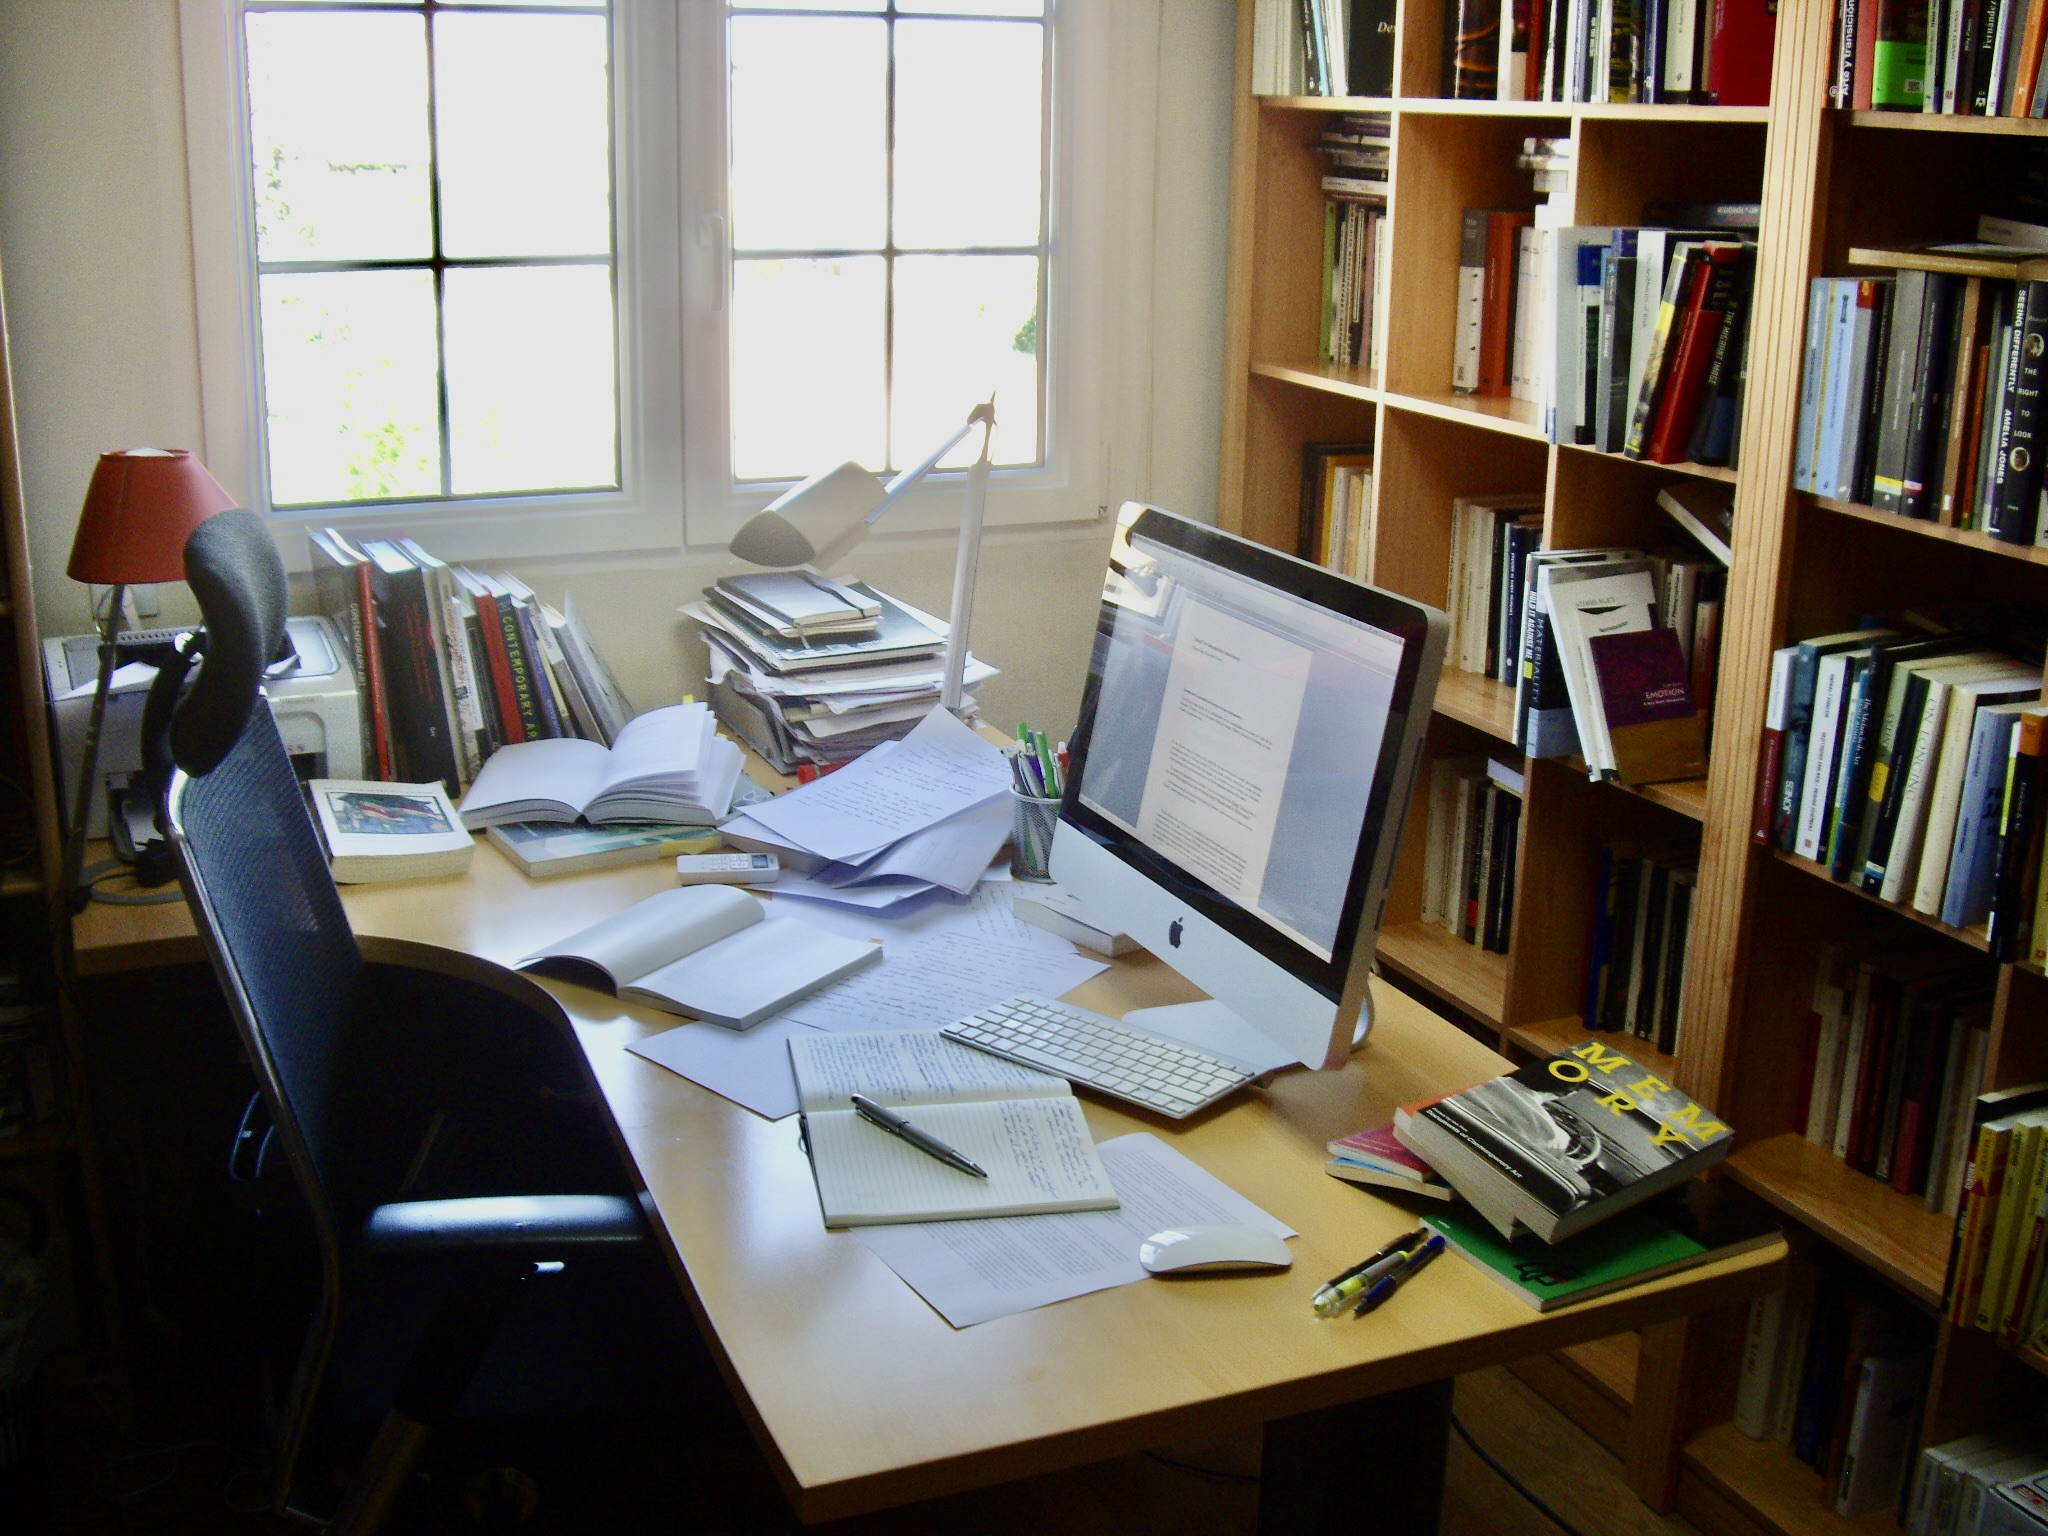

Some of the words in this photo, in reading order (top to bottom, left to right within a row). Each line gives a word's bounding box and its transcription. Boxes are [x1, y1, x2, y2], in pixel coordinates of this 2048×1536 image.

[1844, 0, 1855, 58] transición
[1981, 0, 1998, 49] Fernández
[1841, 70, 1851, 96] Arte
[1723, 310, 1735, 323] THE
[2014, 290, 2026, 328] SEEING
[1714, 326, 1731, 360] MIGRANT
[1707, 360, 1722, 385] IMAGE
[2007, 330, 2022, 393] DIFFERENTLY
[2024, 367, 2038, 376] THE
[2017, 387, 2039, 397] RIGHT
[2000, 409, 2012, 448] AMELIA
[2021, 409, 2031, 418] TO
[2013, 429, 2032, 439] LOOK
[1996, 450, 2007, 485] JONES
[1528, 609, 1536, 618] IT
[1529, 590, 1537, 609] HOLD
[1525, 618, 1536, 648] AGAINST
[1524, 648, 1533, 660] ME
[1532, 618, 1544, 703] MATERIALITY
[501, 615, 532, 717] CONTEMPORARY
[525, 723, 539, 739] AR
[1645, 687, 1685, 700] EMOTION
[1862, 698, 1872, 711] The
[1923, 698, 1936, 723] ON
[1856, 712, 1869, 751] Melancholy
[1906, 729, 1930, 802] LONGING
[1782, 780, 1794, 815] JONES
[1426, 1109, 1461, 1134] Documents
[1467, 1137, 1512, 1170] Contemporary
[1510, 1167, 1524, 1179] Art
